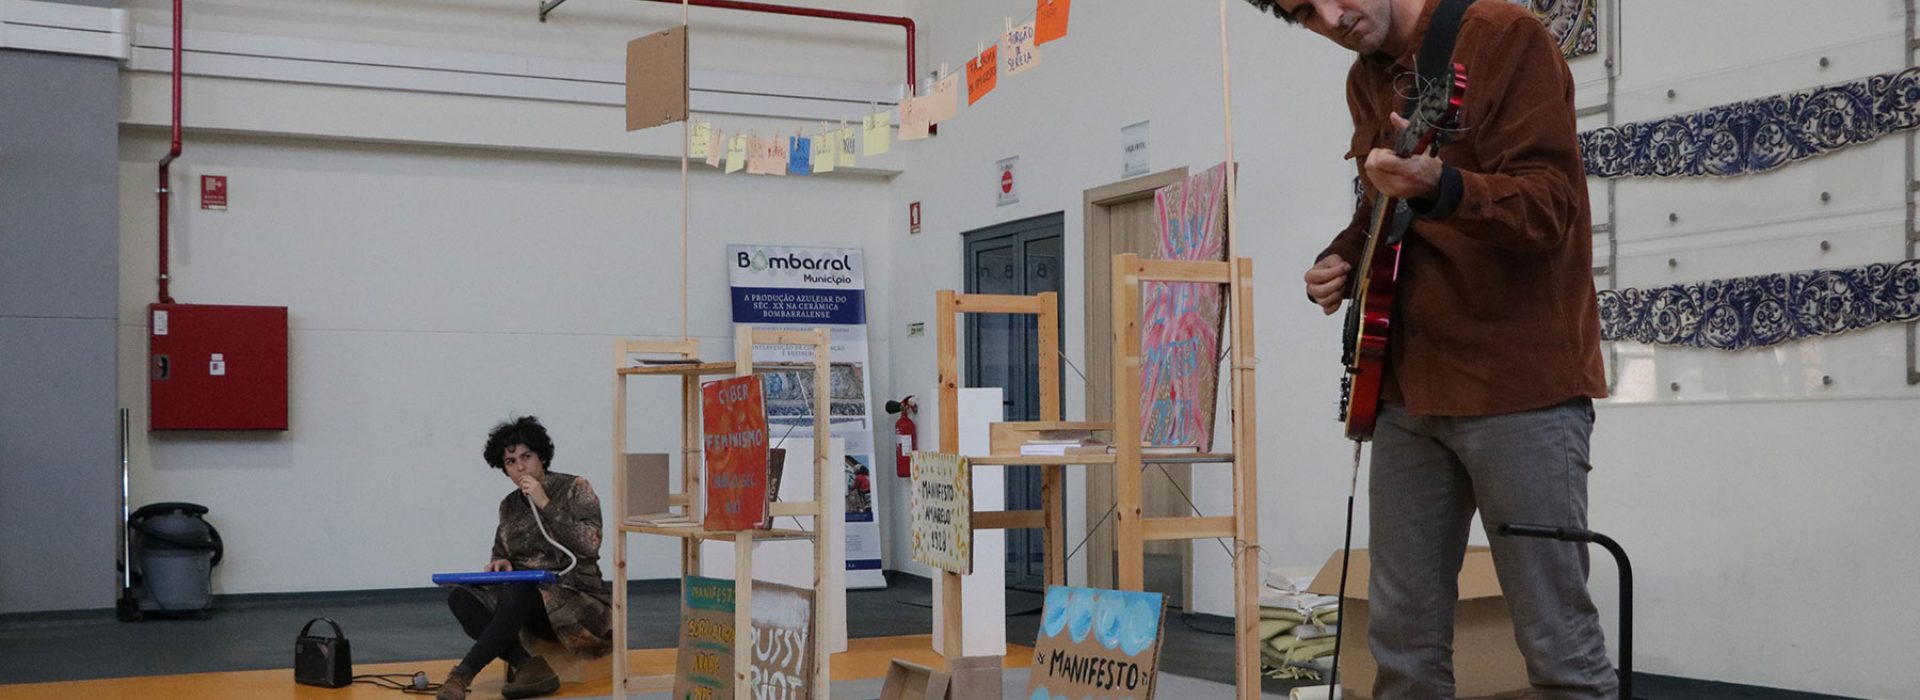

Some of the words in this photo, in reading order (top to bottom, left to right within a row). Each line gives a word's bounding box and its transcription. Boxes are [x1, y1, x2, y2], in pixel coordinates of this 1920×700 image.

[751, 293, 795, 303] PRODUÇÃO
[796, 295, 834, 303] AZULEJAR
[798, 302, 839, 311] CERÂMICA
[763, 310, 831, 319] BOMBARRALENSE
[718, 384, 749, 404] CYBER
[706, 429, 763, 450] FEMINISMO
[922, 480, 954, 502] MANIFESTO
[692, 585, 735, 604] MANIFEST
[1049, 649, 1139, 690] MANIFESTO
